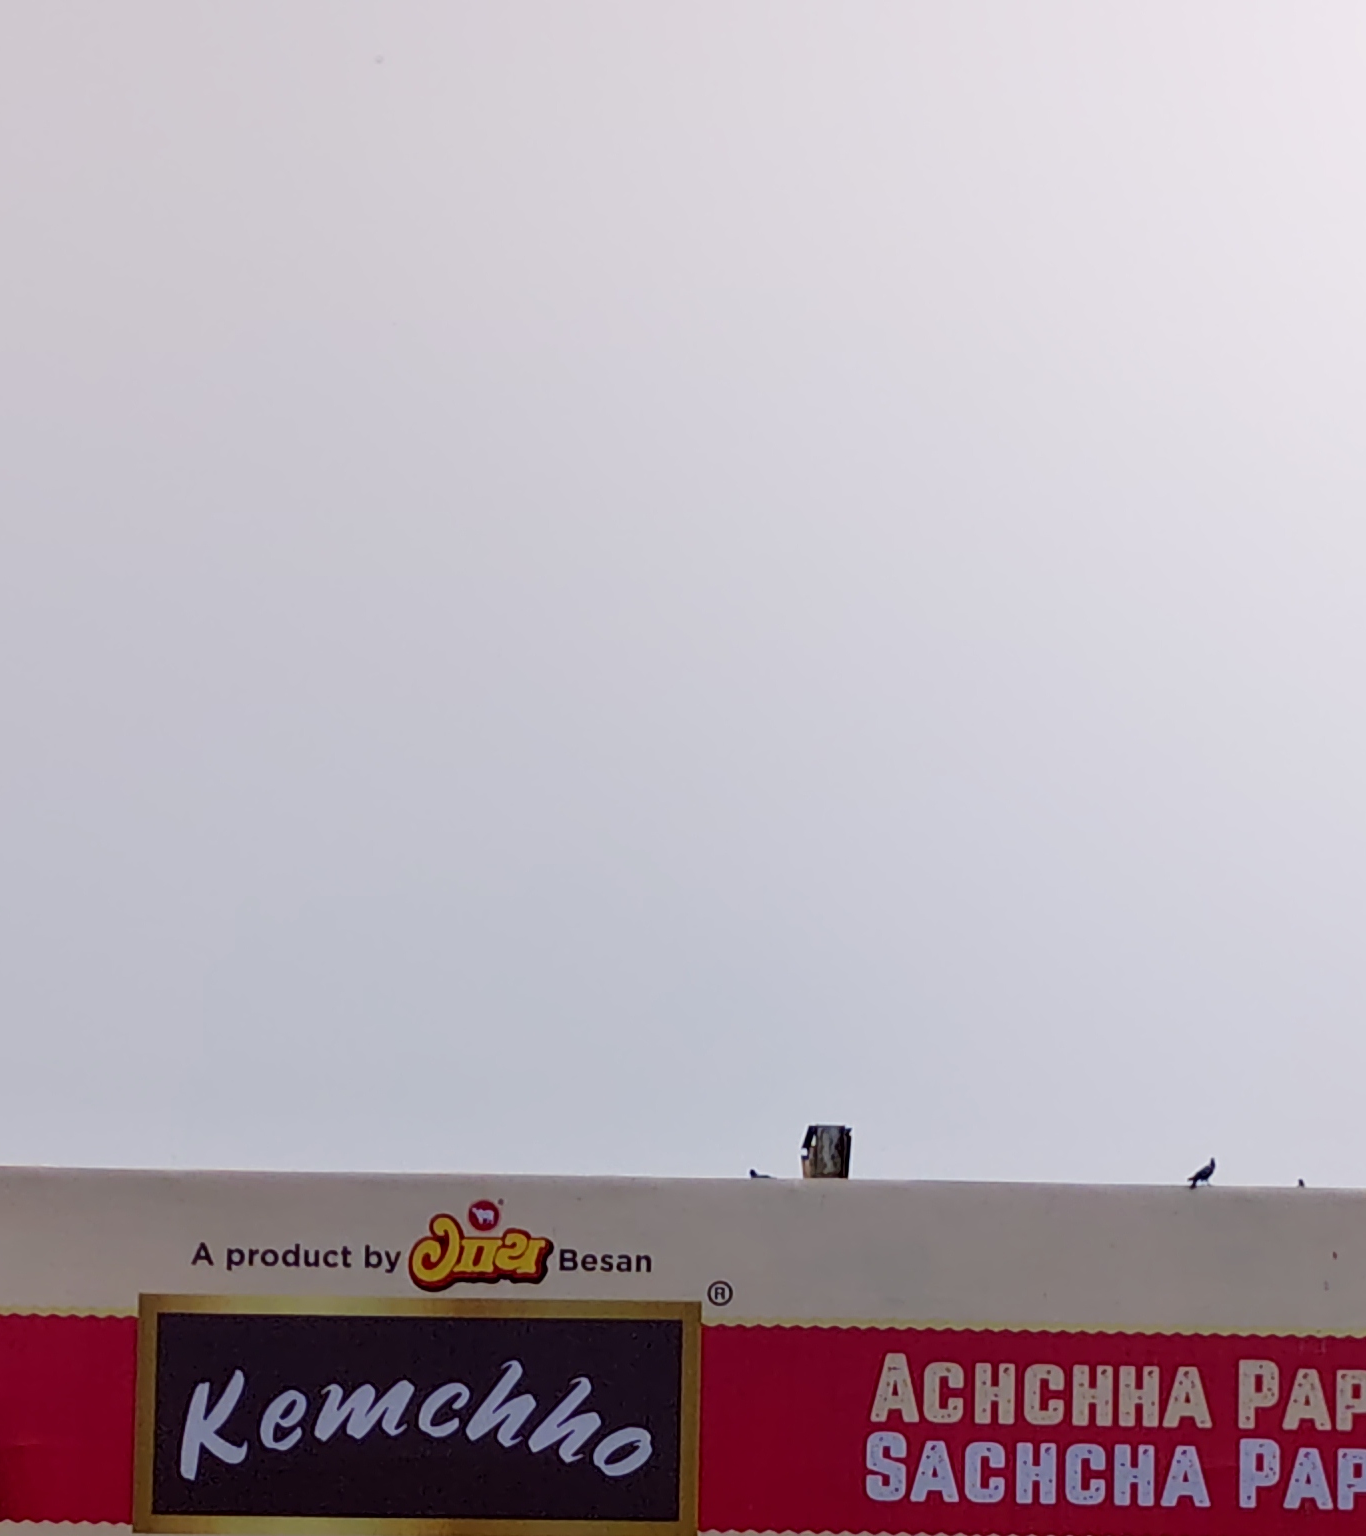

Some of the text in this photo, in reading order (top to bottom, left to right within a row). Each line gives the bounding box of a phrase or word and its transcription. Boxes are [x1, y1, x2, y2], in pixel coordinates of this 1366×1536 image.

[192, 1243, 399, 1272] A product by
[560, 1250, 652, 1273] Besan
[180, 1360, 654, 1481] Kemchho
[870, 1353, 1212, 1428] ACHCHHA
[865, 1431, 1211, 1509] SACHCHA
